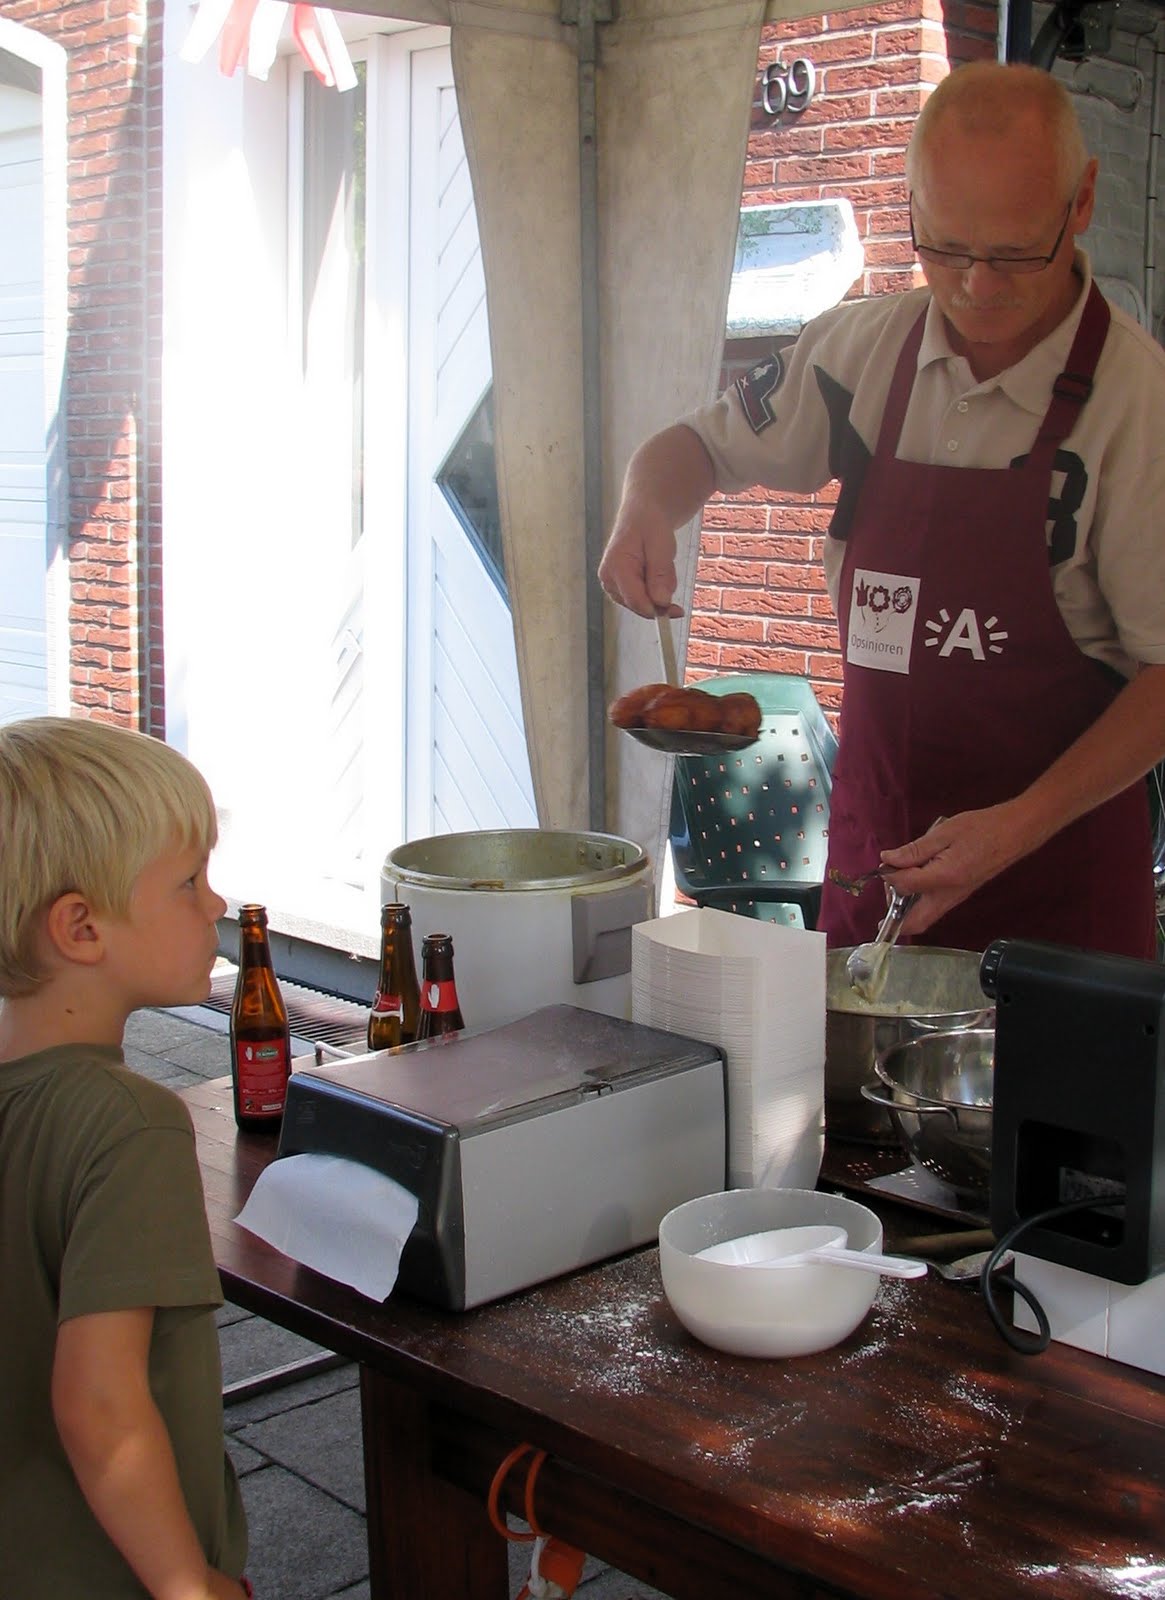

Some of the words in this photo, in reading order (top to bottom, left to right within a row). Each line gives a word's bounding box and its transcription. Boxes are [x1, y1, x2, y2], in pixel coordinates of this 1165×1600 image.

[762, 58, 816, 114] 69
[850, 634, 904, 657] Opsinjoren
[938, 608, 986, 661] A
